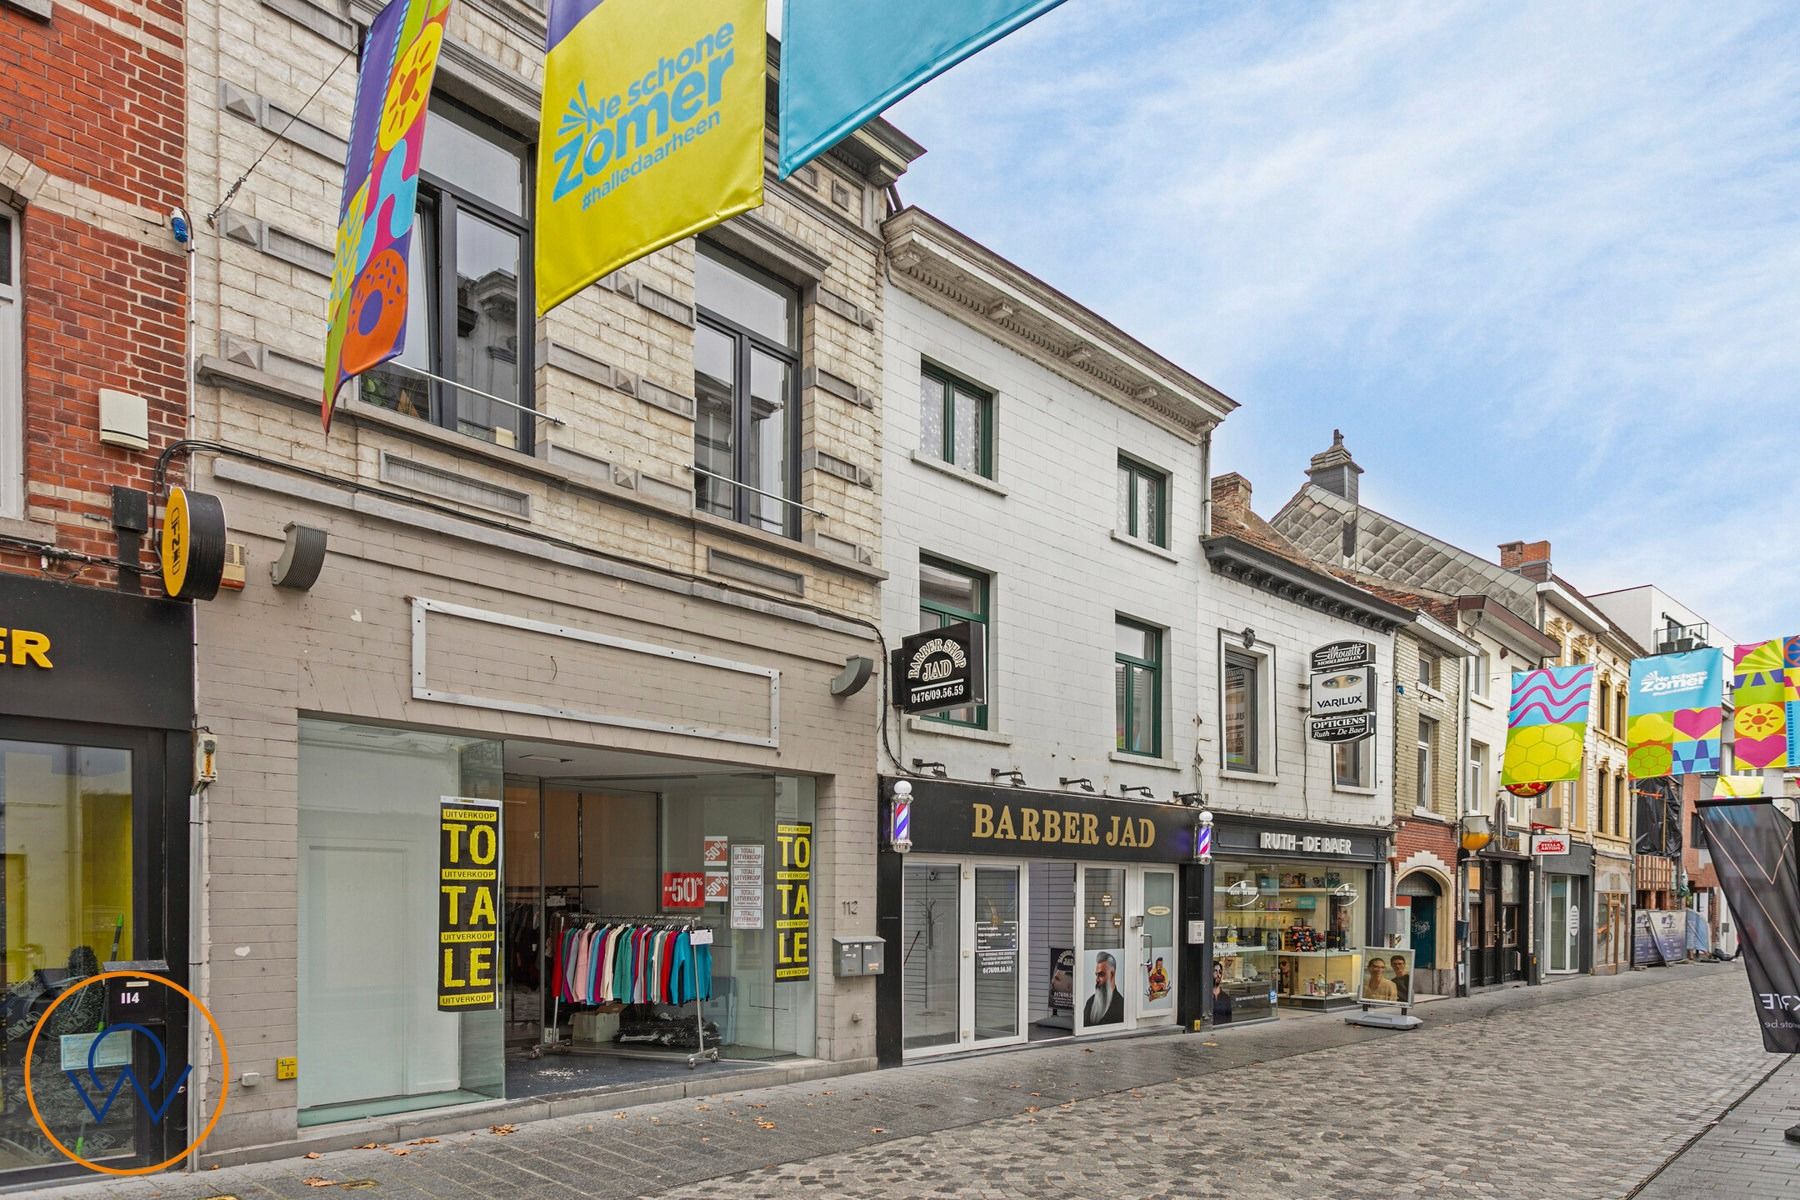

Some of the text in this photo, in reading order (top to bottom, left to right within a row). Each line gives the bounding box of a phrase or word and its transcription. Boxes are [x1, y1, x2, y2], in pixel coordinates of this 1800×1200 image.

[586, 22, 735, 135] Ne schone
[582, 110, 721, 212] #halledaarheen
[0, 627, 54, 669] R
[907, 638, 967, 680] BARBER SHOP
[922, 659, 952, 682] JAD
[911, 684, 964, 704] 0476/09.56.59
[1316, 695, 1363, 708] VARILUX
[1312, 716, 1366, 730] OPTICIENS
[1313, 730, 1330, 738] Ruth
[1337, 728, 1347, 736] De
[1348, 726, 1366, 734] Baer
[445, 810, 495, 820] UITVERKOOP
[971, 803, 1156, 848] BARBER JAD
[442, 823, 497, 865] TO
[777, 836, 811, 868] TO
[444, 870, 494, 879] UITVERKOOP
[664, 877, 704, 902] -50%
[776, 884, 809, 915] TA
[441, 885, 497, 925] TA
[842, 900, 858, 915] 112
[443, 932, 493, 941] UITVERKOOP
[778, 932, 808, 963] LE
[443, 947, 492, 988] LE
[121, 992, 140, 1004] 114
[442, 994, 492, 1004] UITVERKOOP
